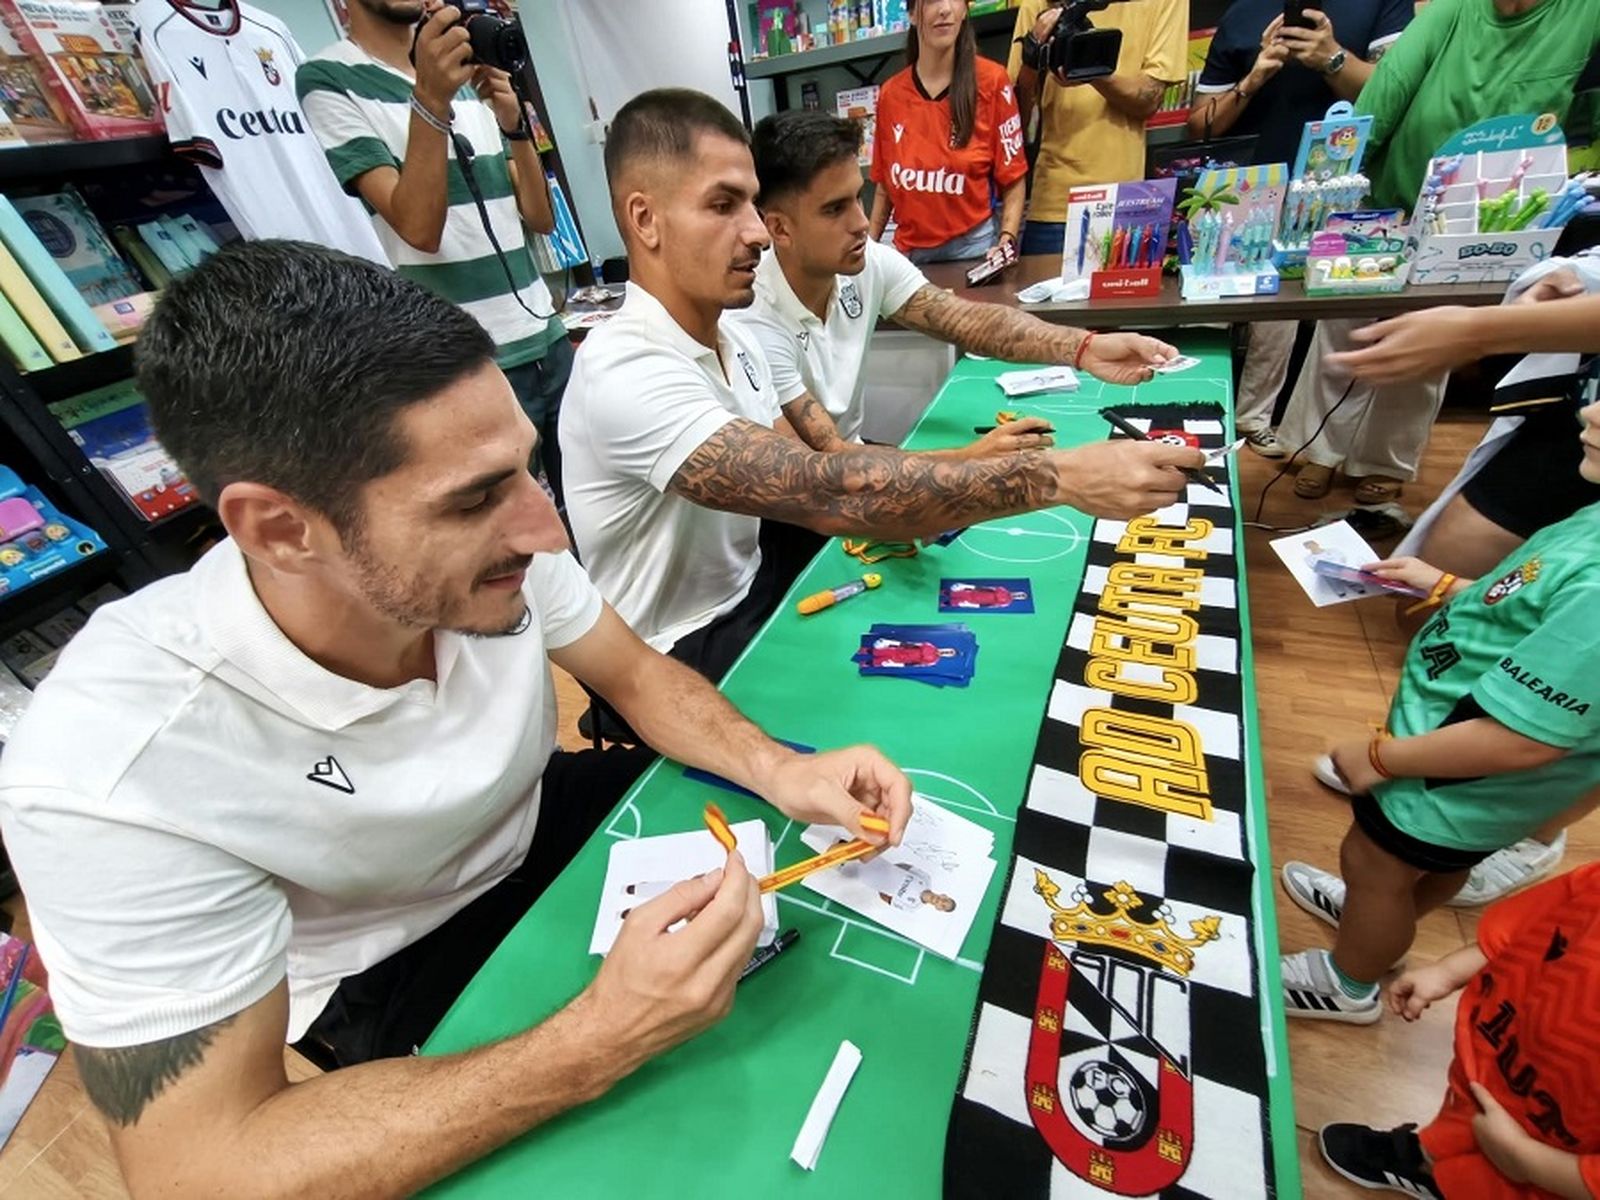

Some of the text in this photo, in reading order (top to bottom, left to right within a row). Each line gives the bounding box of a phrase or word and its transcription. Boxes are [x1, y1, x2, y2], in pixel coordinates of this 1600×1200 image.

[216, 106, 305, 140] Ceuta
[890, 164, 965, 196] Ceuta
[1114, 513, 1215, 561] FC
[1083, 561, 1206, 706] CEUTA
[1078, 707, 1215, 824] AD
